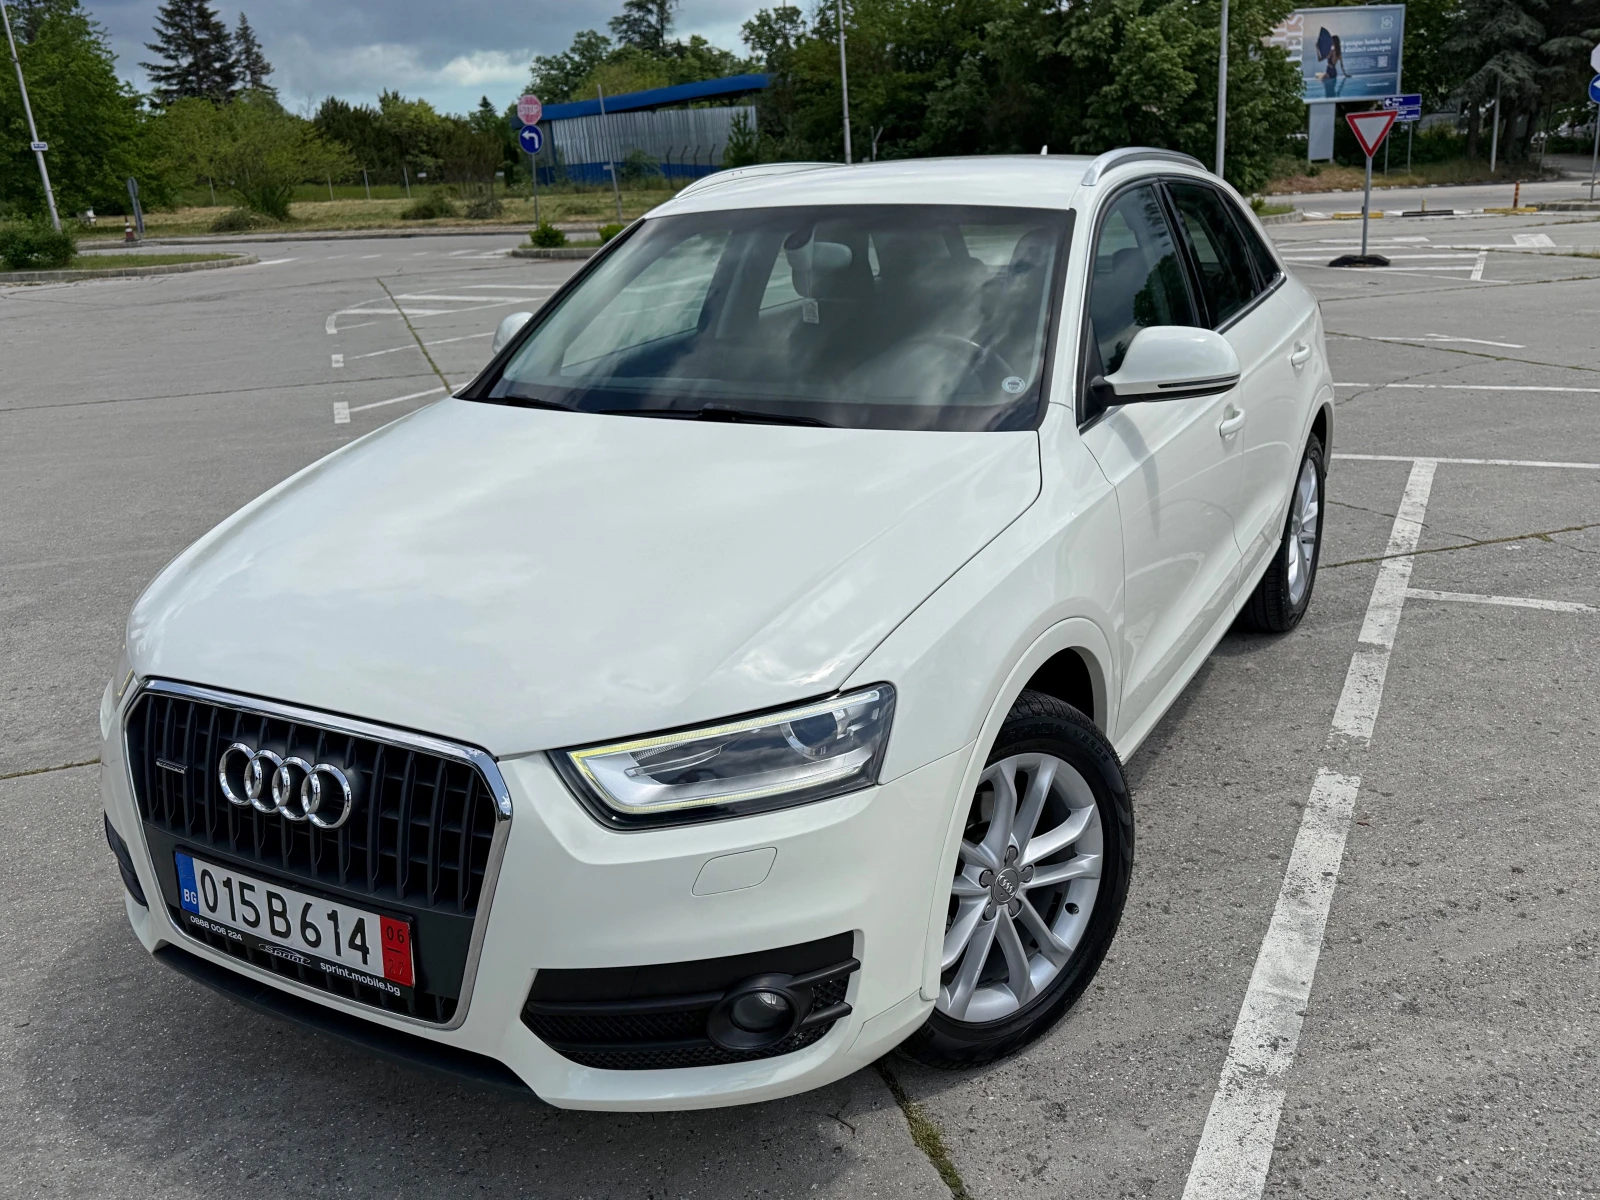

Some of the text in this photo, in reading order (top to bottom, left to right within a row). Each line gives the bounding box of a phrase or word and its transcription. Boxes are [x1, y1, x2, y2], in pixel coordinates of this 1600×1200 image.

[519, 104, 539, 115] STOP
[183, 888, 198, 905] BG
[200, 868, 370, 967] 015B614
[210, 923, 227, 935] 006
[227, 930, 243, 941] 224
[386, 925, 405, 944] 06
[320, 961, 400, 996] sprint.mobile.bg
